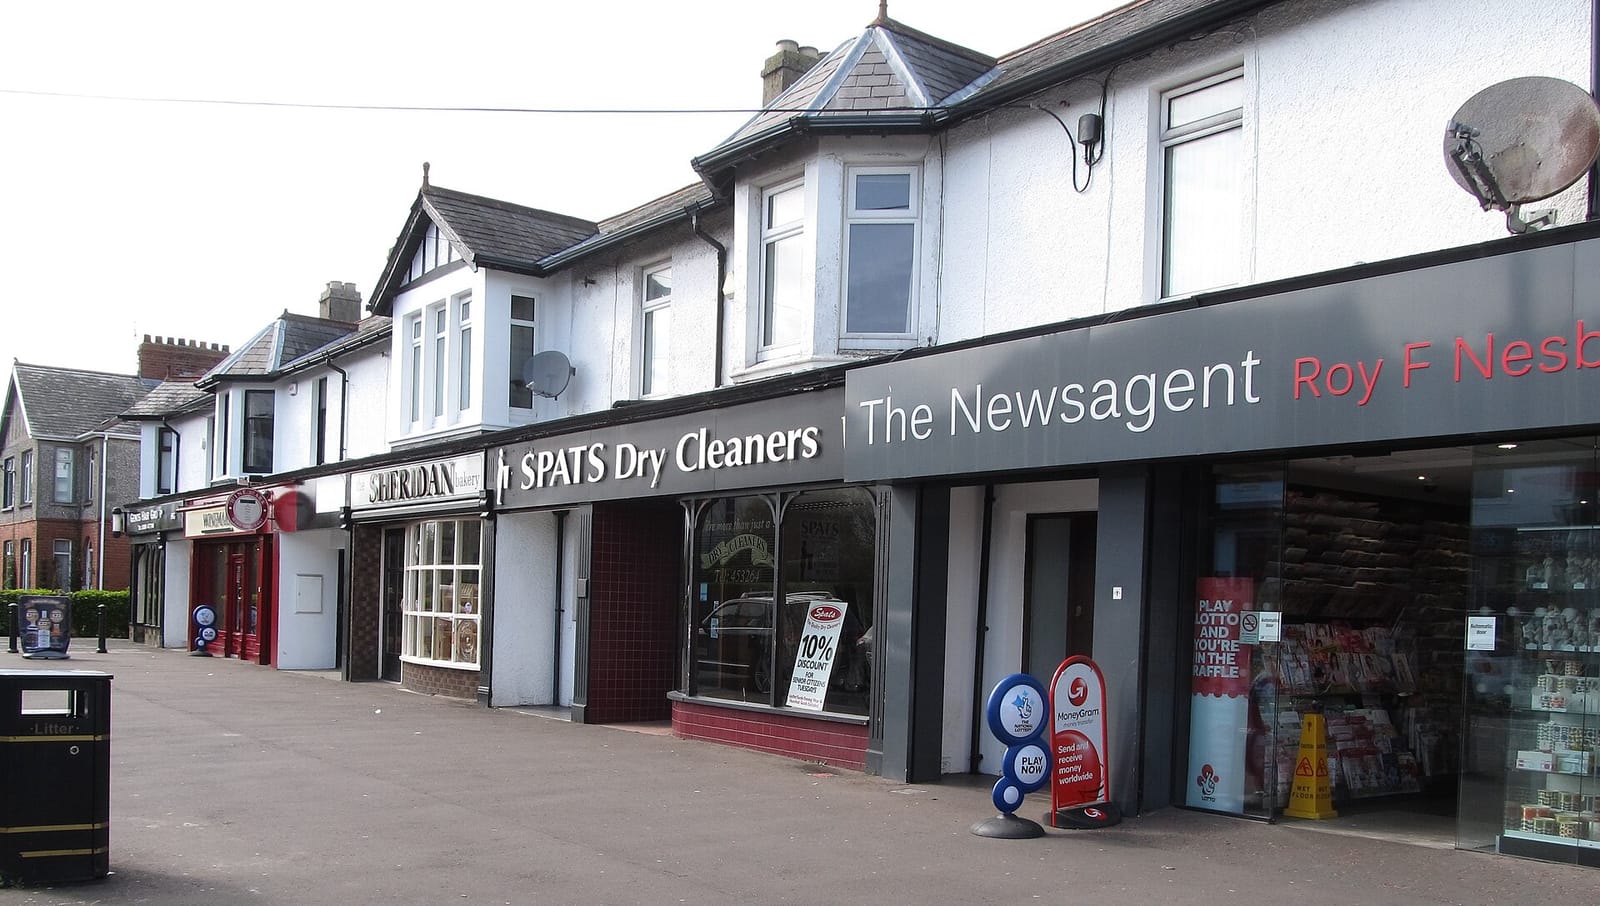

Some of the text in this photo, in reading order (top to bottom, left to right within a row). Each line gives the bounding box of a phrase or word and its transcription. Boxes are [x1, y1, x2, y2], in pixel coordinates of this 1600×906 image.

[860, 391, 934, 446] The
[949, 350, 1261, 434] Newsagent
[1294, 356, 1384, 407] Roy
[1403, 341, 1432, 389] F
[520, 426, 820, 491] SPATS Dry Cleaners
[369, 462, 456, 504] SHERIDAN
[455, 472, 481, 490] bakery
[801, 520, 839, 537] SPATS
[709, 535, 765, 565] DRY CLEANERS
[1199, 599, 1233, 612] PLAY
[1194, 612, 1239, 626] LOTTO
[1200, 626, 1230, 638] AND
[802, 634, 834, 661] 10%
[1194, 638, 1240, 652] YOU'RE
[1195, 651, 1236, 665] IN THE
[797, 659, 829, 672] DISCOUNT
[1192, 665, 1239, 678] RAFFLE
[805, 671, 814, 679] FOR
[793, 677, 826, 688] SENIOR CITIZENS
[1057, 708, 1099, 721] MoneyGram
[34, 723, 74, 735] Litter
[1058, 741, 1089, 754] Send and
[1021, 756, 1043, 766] PLAY
[1058, 753, 1083, 765] receive
[1021, 765, 1043, 775] NOW
[1058, 764, 1082, 775] money
[1059, 772, 1094, 785] worldwide
